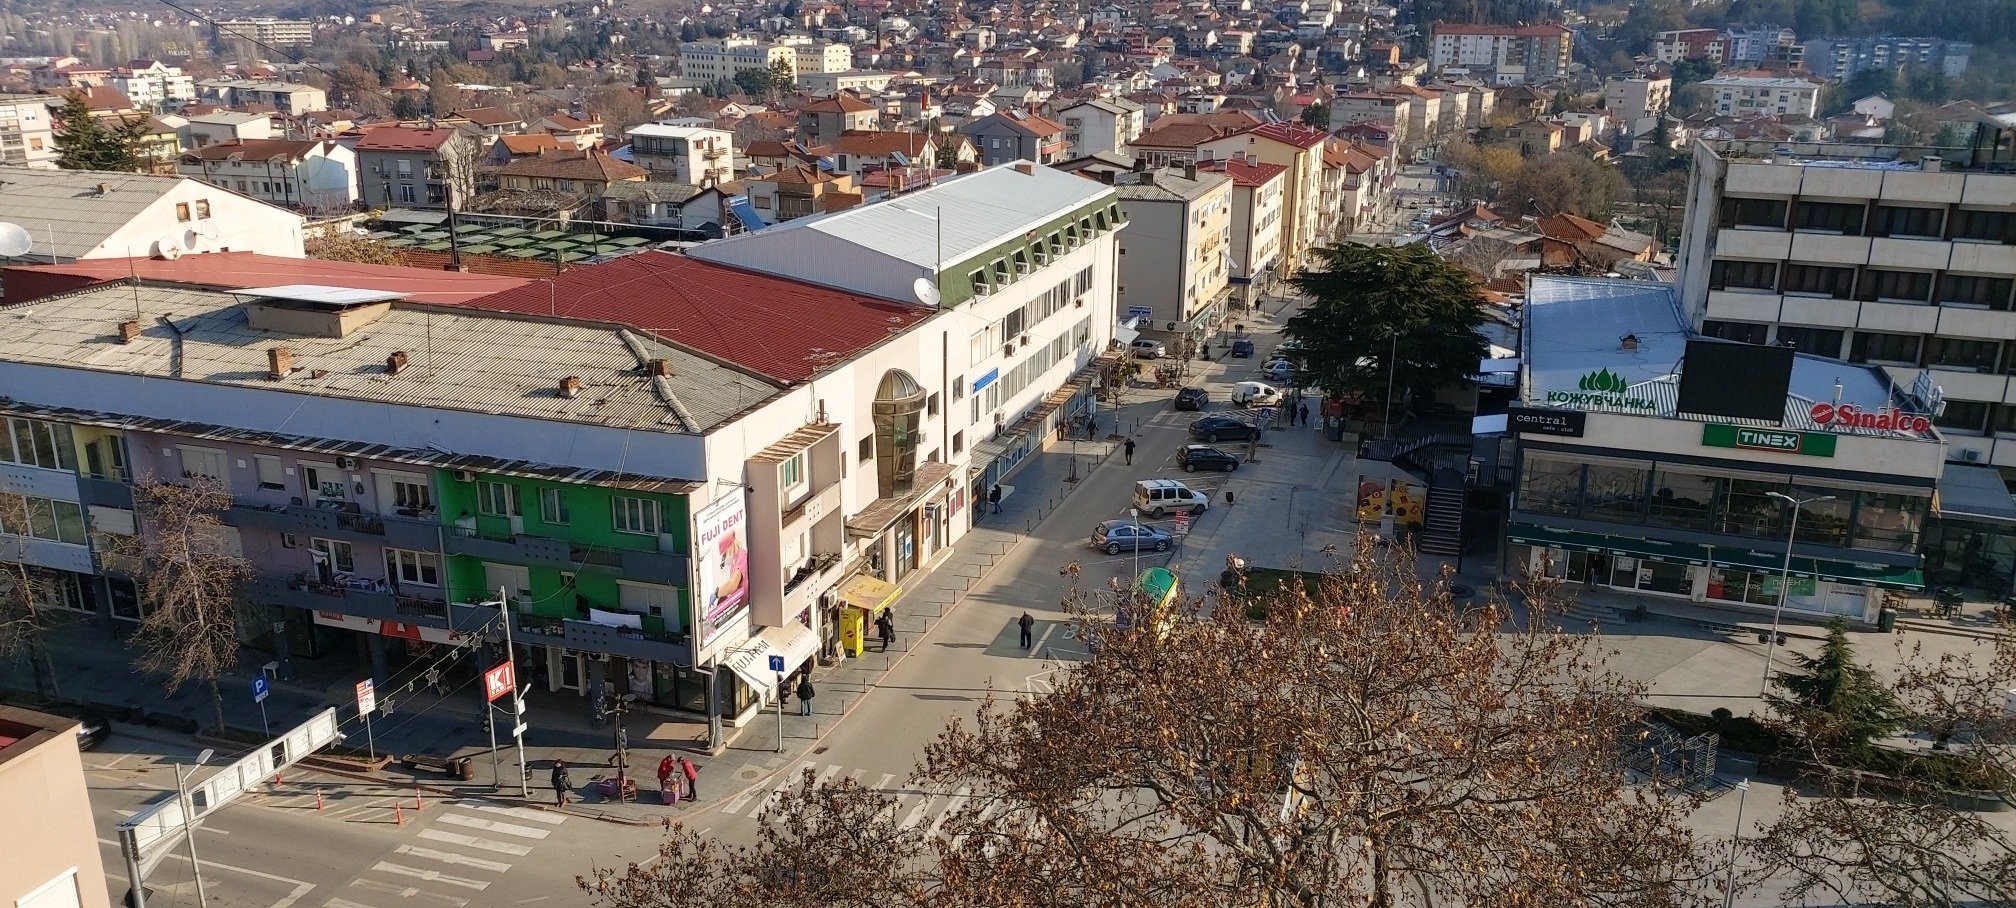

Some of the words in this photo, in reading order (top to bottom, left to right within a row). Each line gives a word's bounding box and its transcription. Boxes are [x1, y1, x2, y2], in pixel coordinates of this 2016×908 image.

[1547, 391, 1657, 411] КОЖУВЧАНКА
[1516, 413, 1567, 427] central
[1836, 403, 1931, 432] Sinalco
[1740, 431, 1796, 448] TINEX
[701, 525, 721, 546] FUJI
[722, 508, 744, 532] DENT
[255, 679, 264, 693] P
